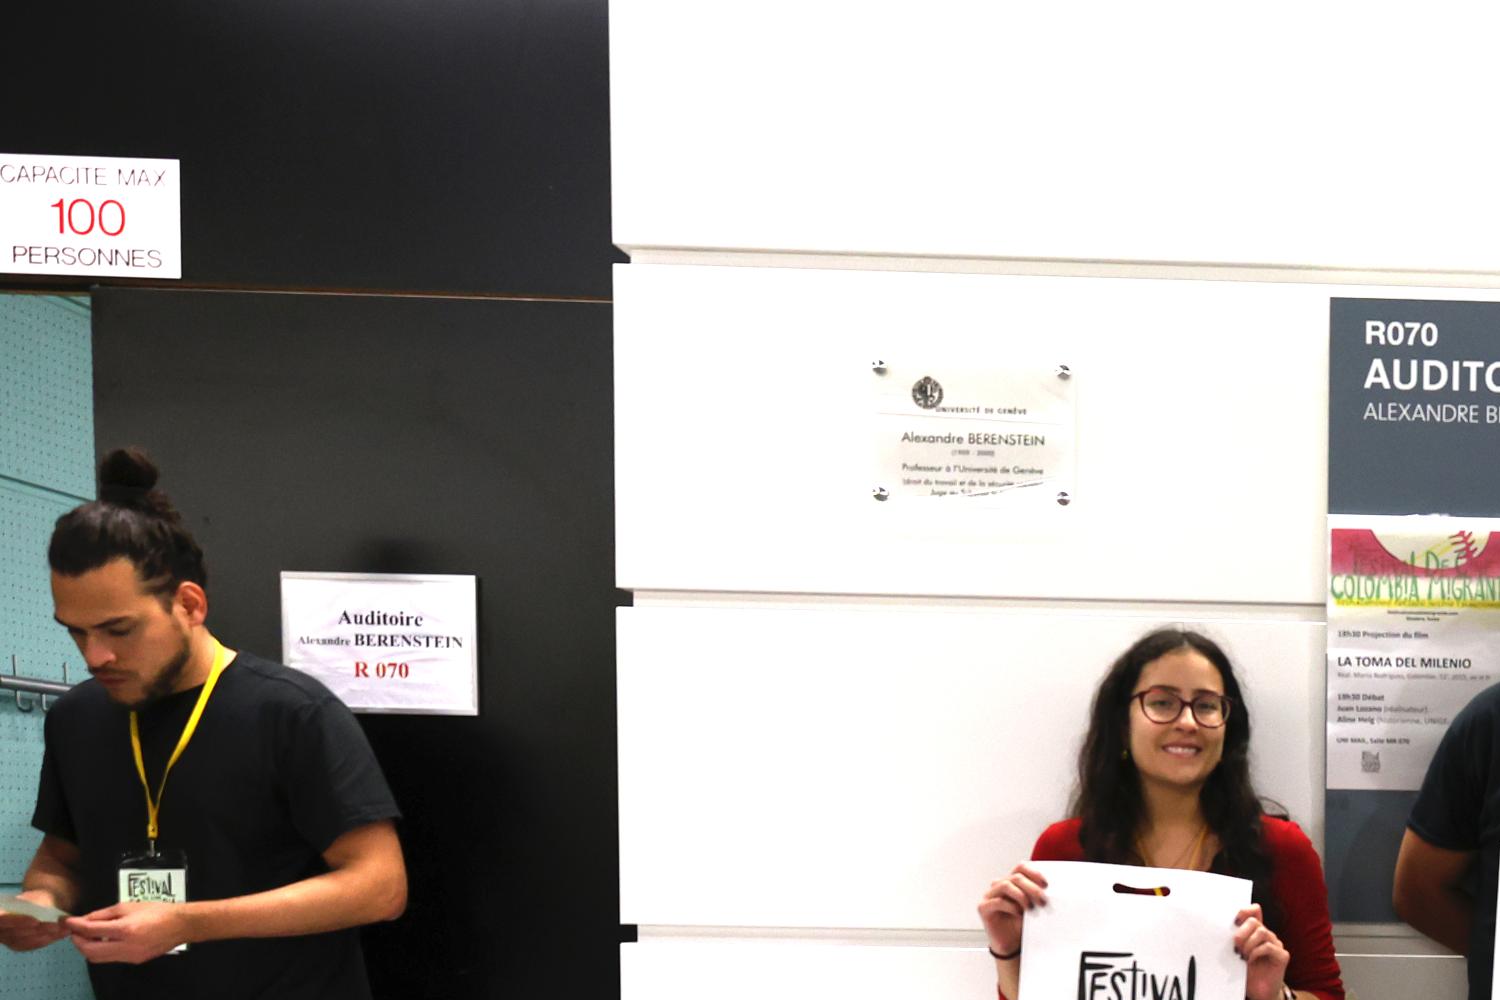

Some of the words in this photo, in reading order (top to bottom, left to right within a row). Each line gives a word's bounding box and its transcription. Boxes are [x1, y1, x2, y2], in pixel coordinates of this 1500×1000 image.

[0, 164, 107, 186] CAPACITE
[118, 168, 167, 187] MAX
[51, 198, 126, 236] 100
[13, 246, 162, 268] PERSONNES
[1365, 320, 1439, 347] R070
[935, 406, 981, 415] UNIVERSITÉ
[1363, 403, 1479, 424] ALEXANDRE
[901, 431, 964, 445] Alexandre
[968, 432, 1046, 447] BERENSTEIN
[902, 463, 943, 473] Professeur
[1000, 465, 1010, 475] de
[338, 609, 424, 627] Auditoire
[298, 635, 351, 646] Alexandre
[354, 633, 463, 648] BERENSTEIN
[1363, 631, 1400, 639] Projection
[354, 661, 370, 678] R
[376, 662, 410, 679] 070
[1337, 656, 1352, 667] LA
[1356, 656, 1392, 668] TOMA
[1395, 657, 1417, 668] DEL
[1420, 658, 1471, 669] MILENIO
[1362, 693, 1385, 701] Débat
